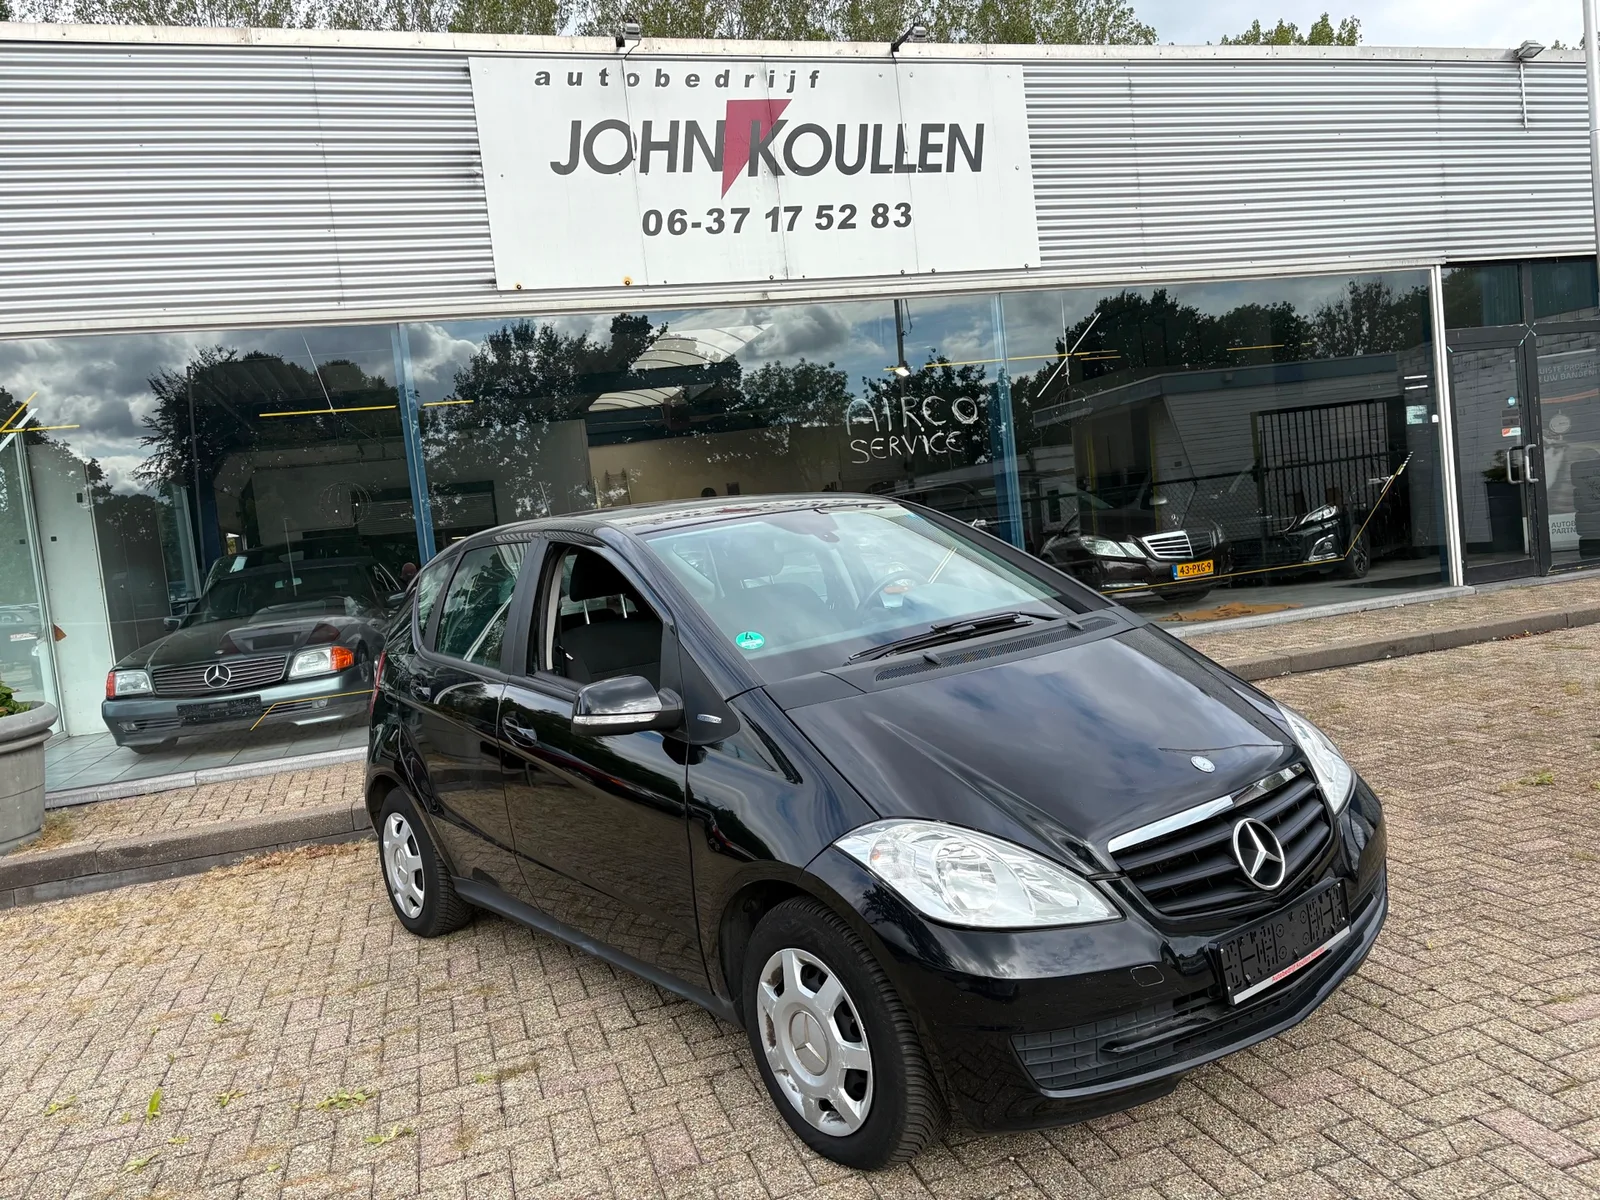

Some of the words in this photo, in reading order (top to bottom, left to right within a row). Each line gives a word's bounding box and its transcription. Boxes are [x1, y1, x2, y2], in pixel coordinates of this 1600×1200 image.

[534, 68, 820, 93] autobedrijf
[550, 118, 725, 176] JOHN
[747, 119, 985, 178] KOULLEN
[641, 207, 750, 237] 06-37
[765, 205, 803, 233] 17
[815, 203, 857, 231] 52
[871, 202, 912, 229] 83
[1538, 366, 1562, 375] UISTE
[846, 396, 979, 436] AIRCO
[1179, 561, 1212, 576] 43-PXG-9
